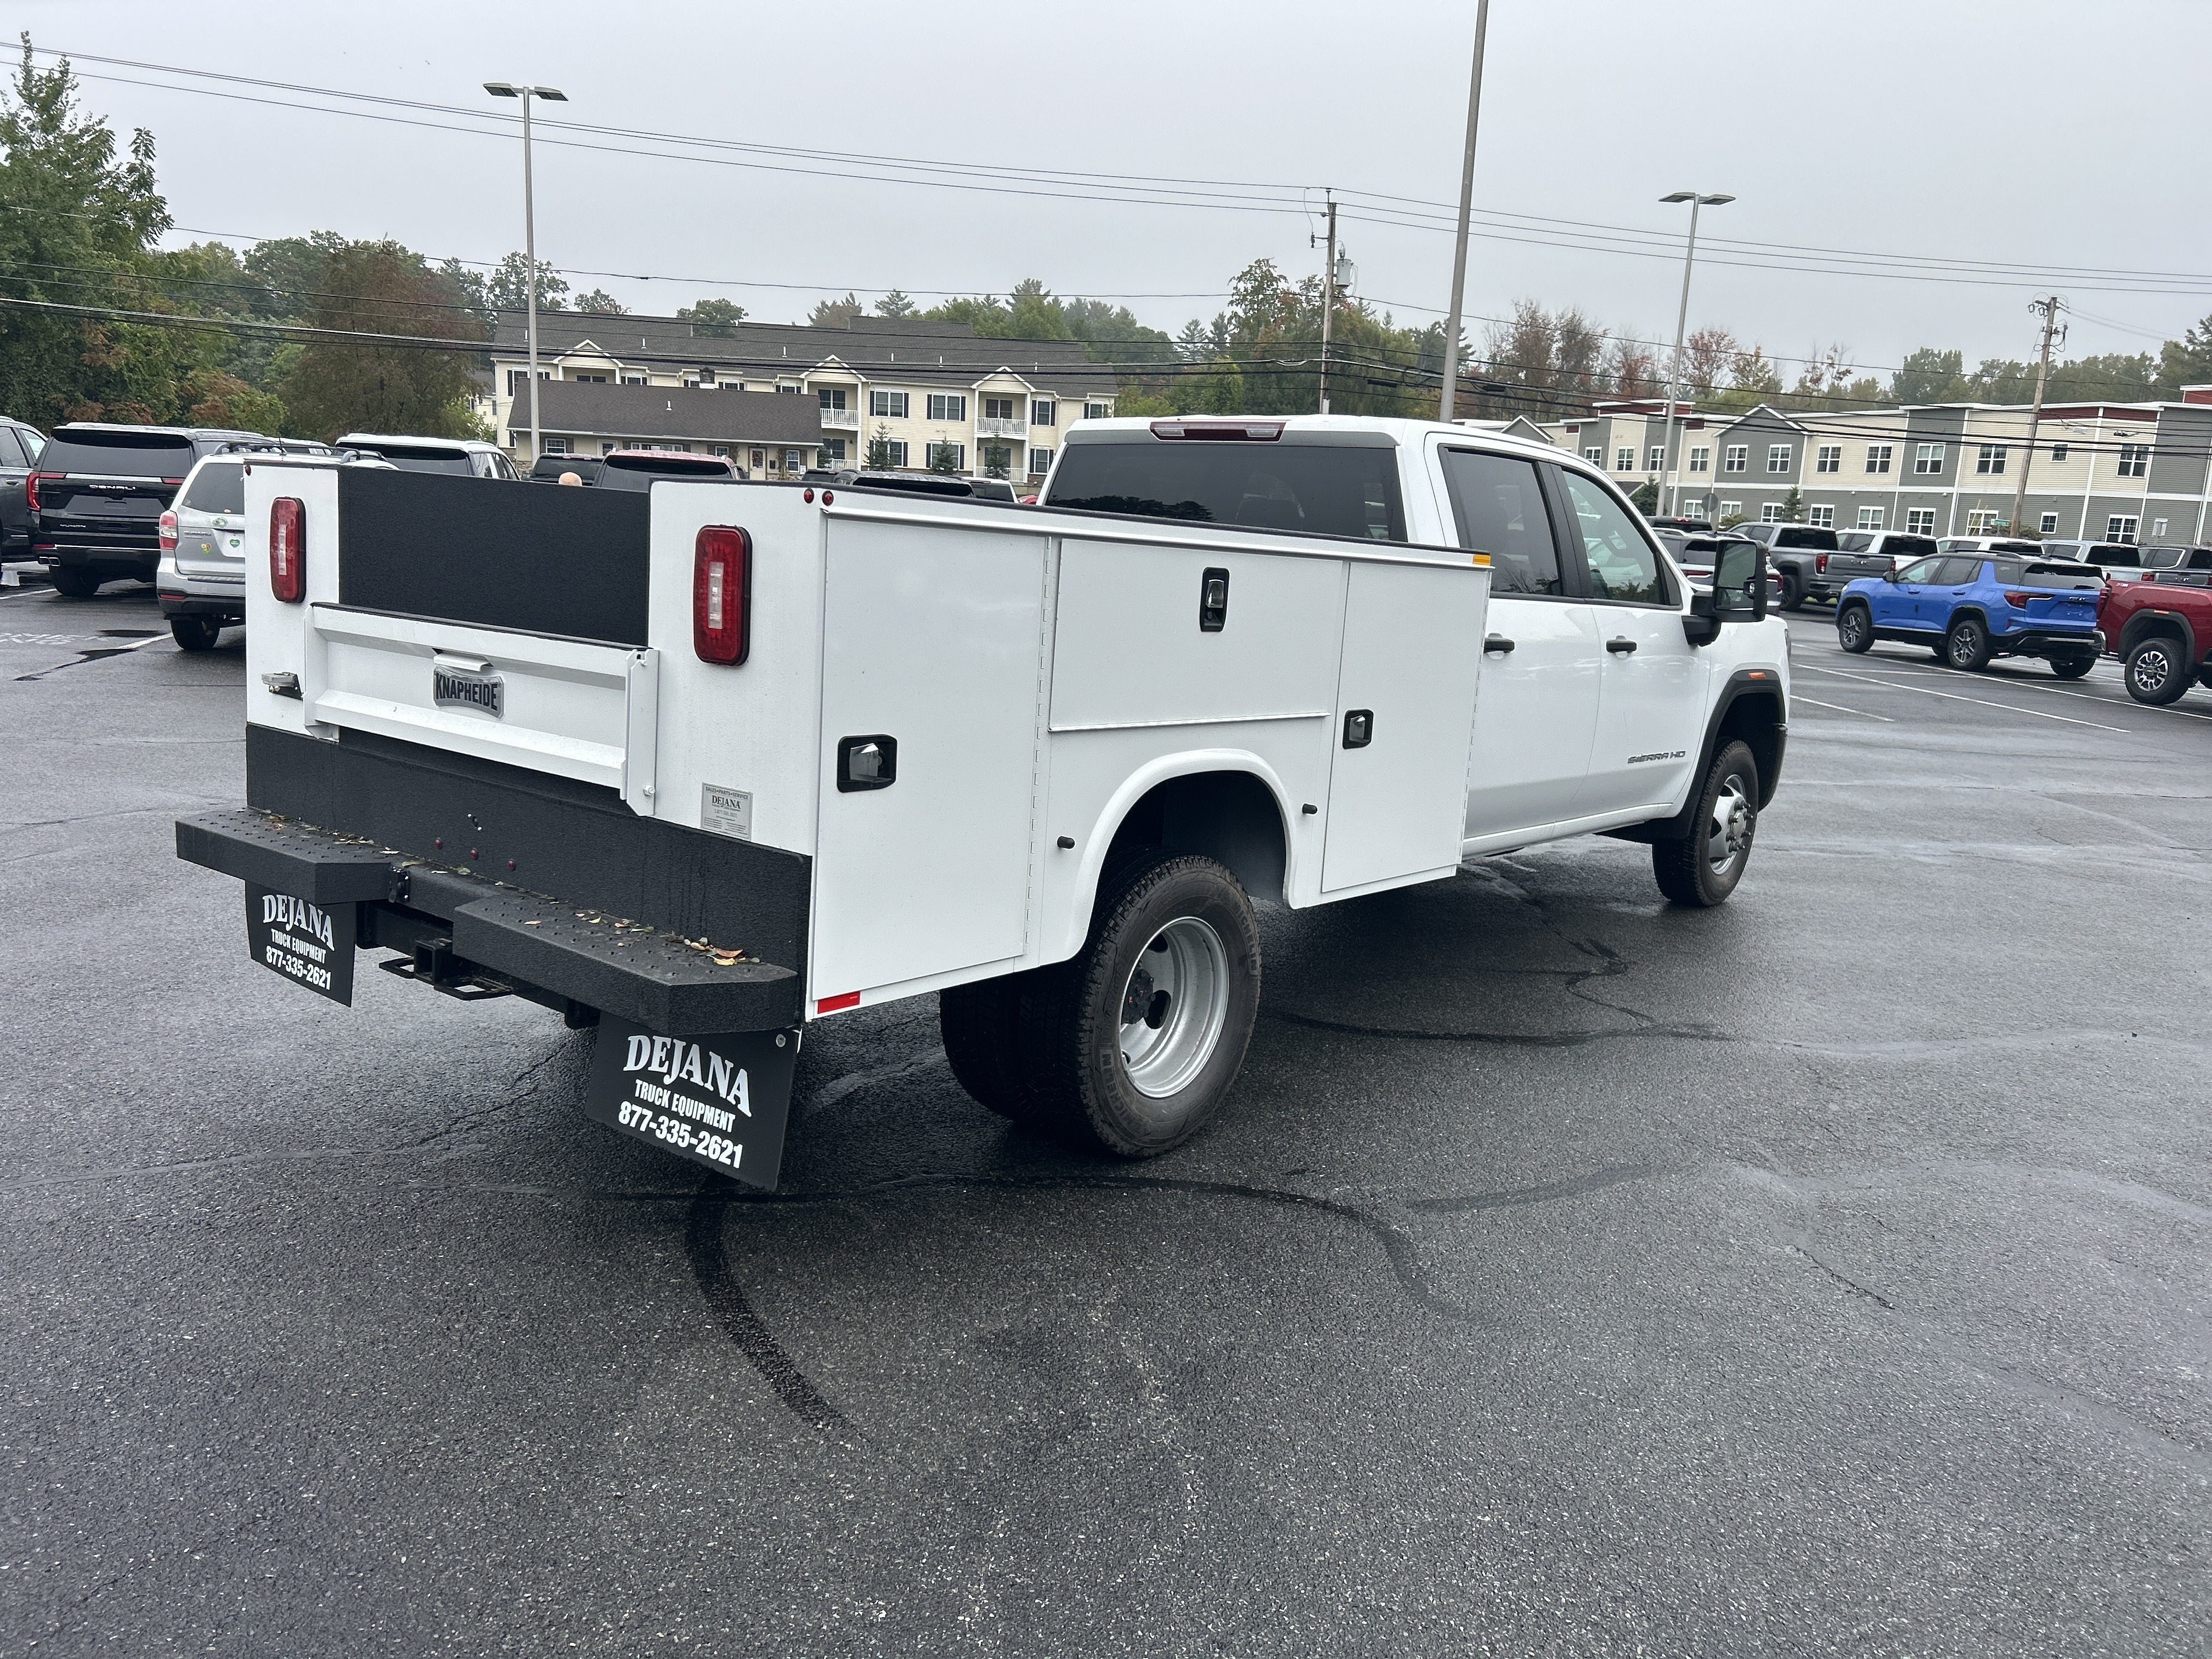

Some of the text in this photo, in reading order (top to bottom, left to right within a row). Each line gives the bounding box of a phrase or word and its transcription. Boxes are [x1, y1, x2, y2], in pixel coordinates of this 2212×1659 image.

[436, 672, 498, 712] KNAPHEIDE
[1628, 751, 1686, 764] SIERRA HD
[712, 795, 741, 809] DEJANA
[263, 894, 335, 951] DEJANA
[266, 945, 331, 990] 877-335-2621
[271, 928, 326, 964] TRUCK EQUIPMENT
[623, 1035, 752, 1118] DEJANA
[635, 1079, 736, 1133] TRUCK EQUIPMENT
[618, 1101, 743, 1169] 877-335-2621
